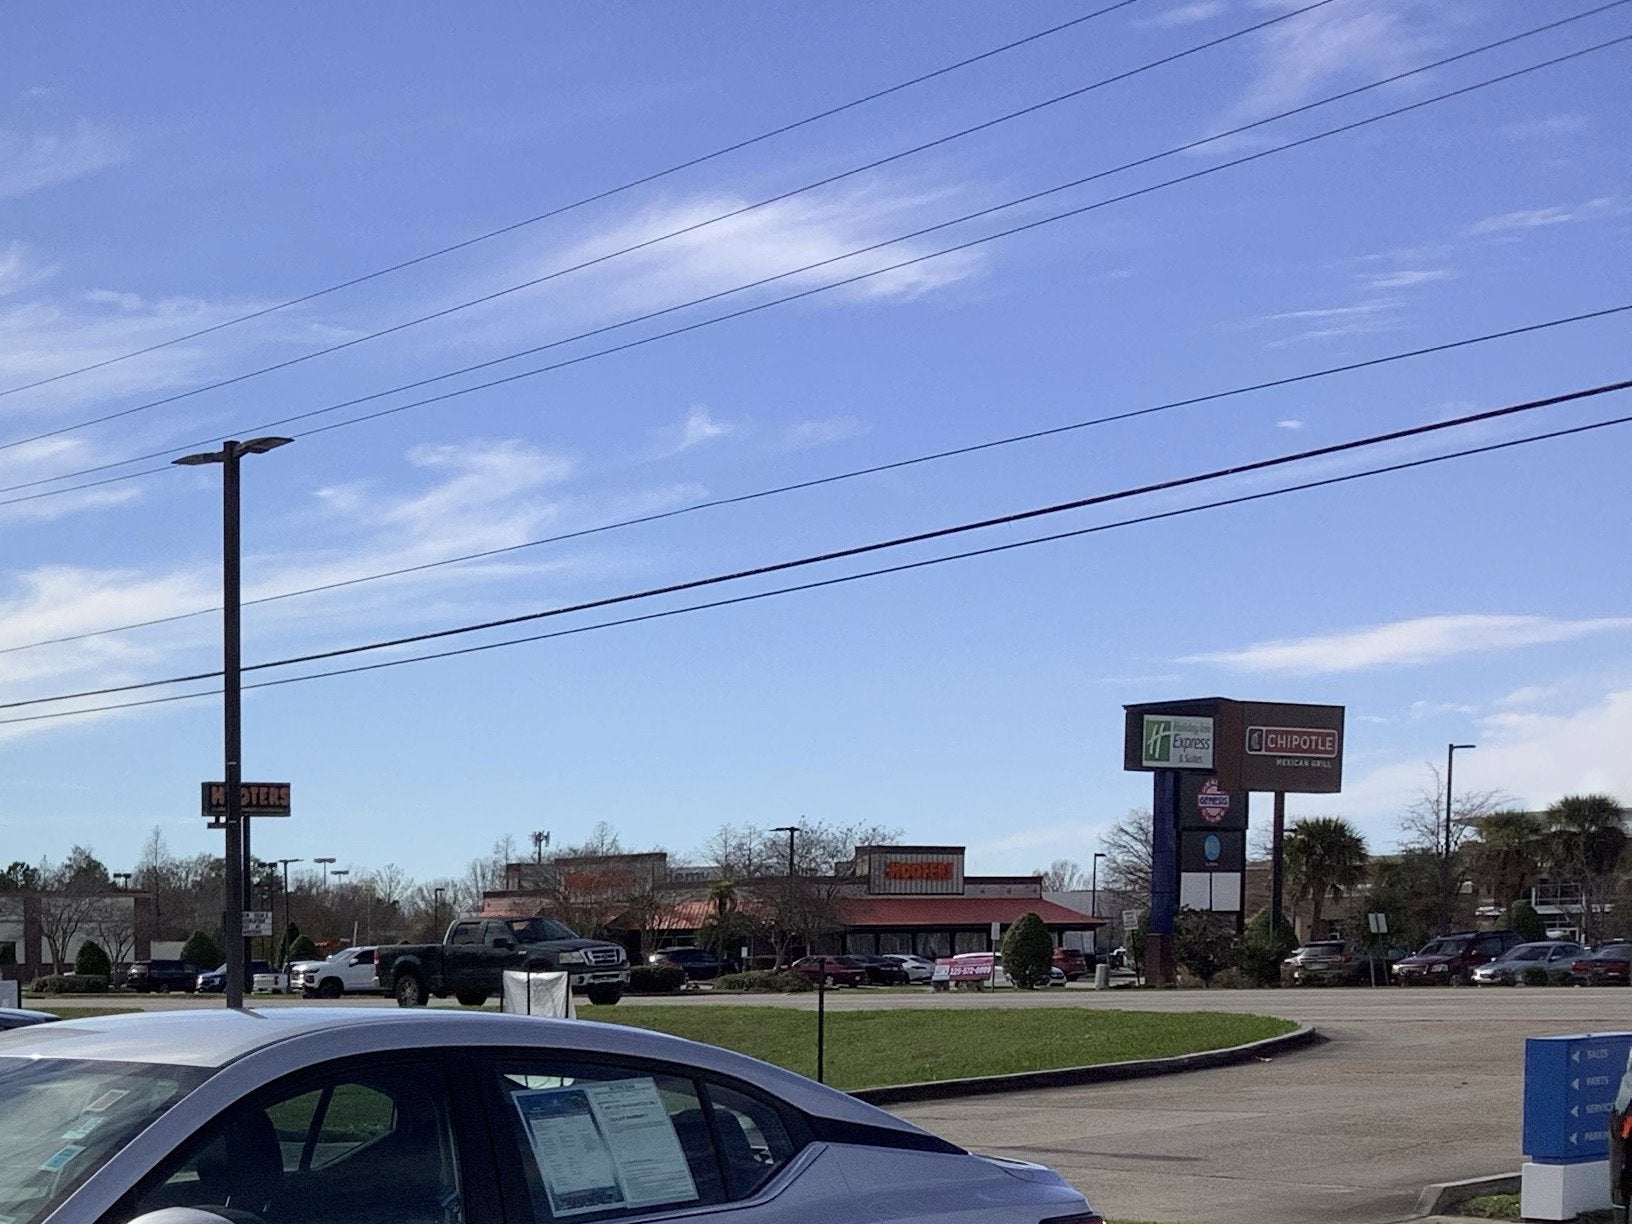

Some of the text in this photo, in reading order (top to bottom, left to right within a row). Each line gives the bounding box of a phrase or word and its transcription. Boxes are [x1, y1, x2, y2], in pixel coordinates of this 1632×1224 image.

[1172, 734, 1210, 751] Express
[1267, 734, 1334, 751] CHIPOTLE
[210, 785, 289, 806] HOTERS
